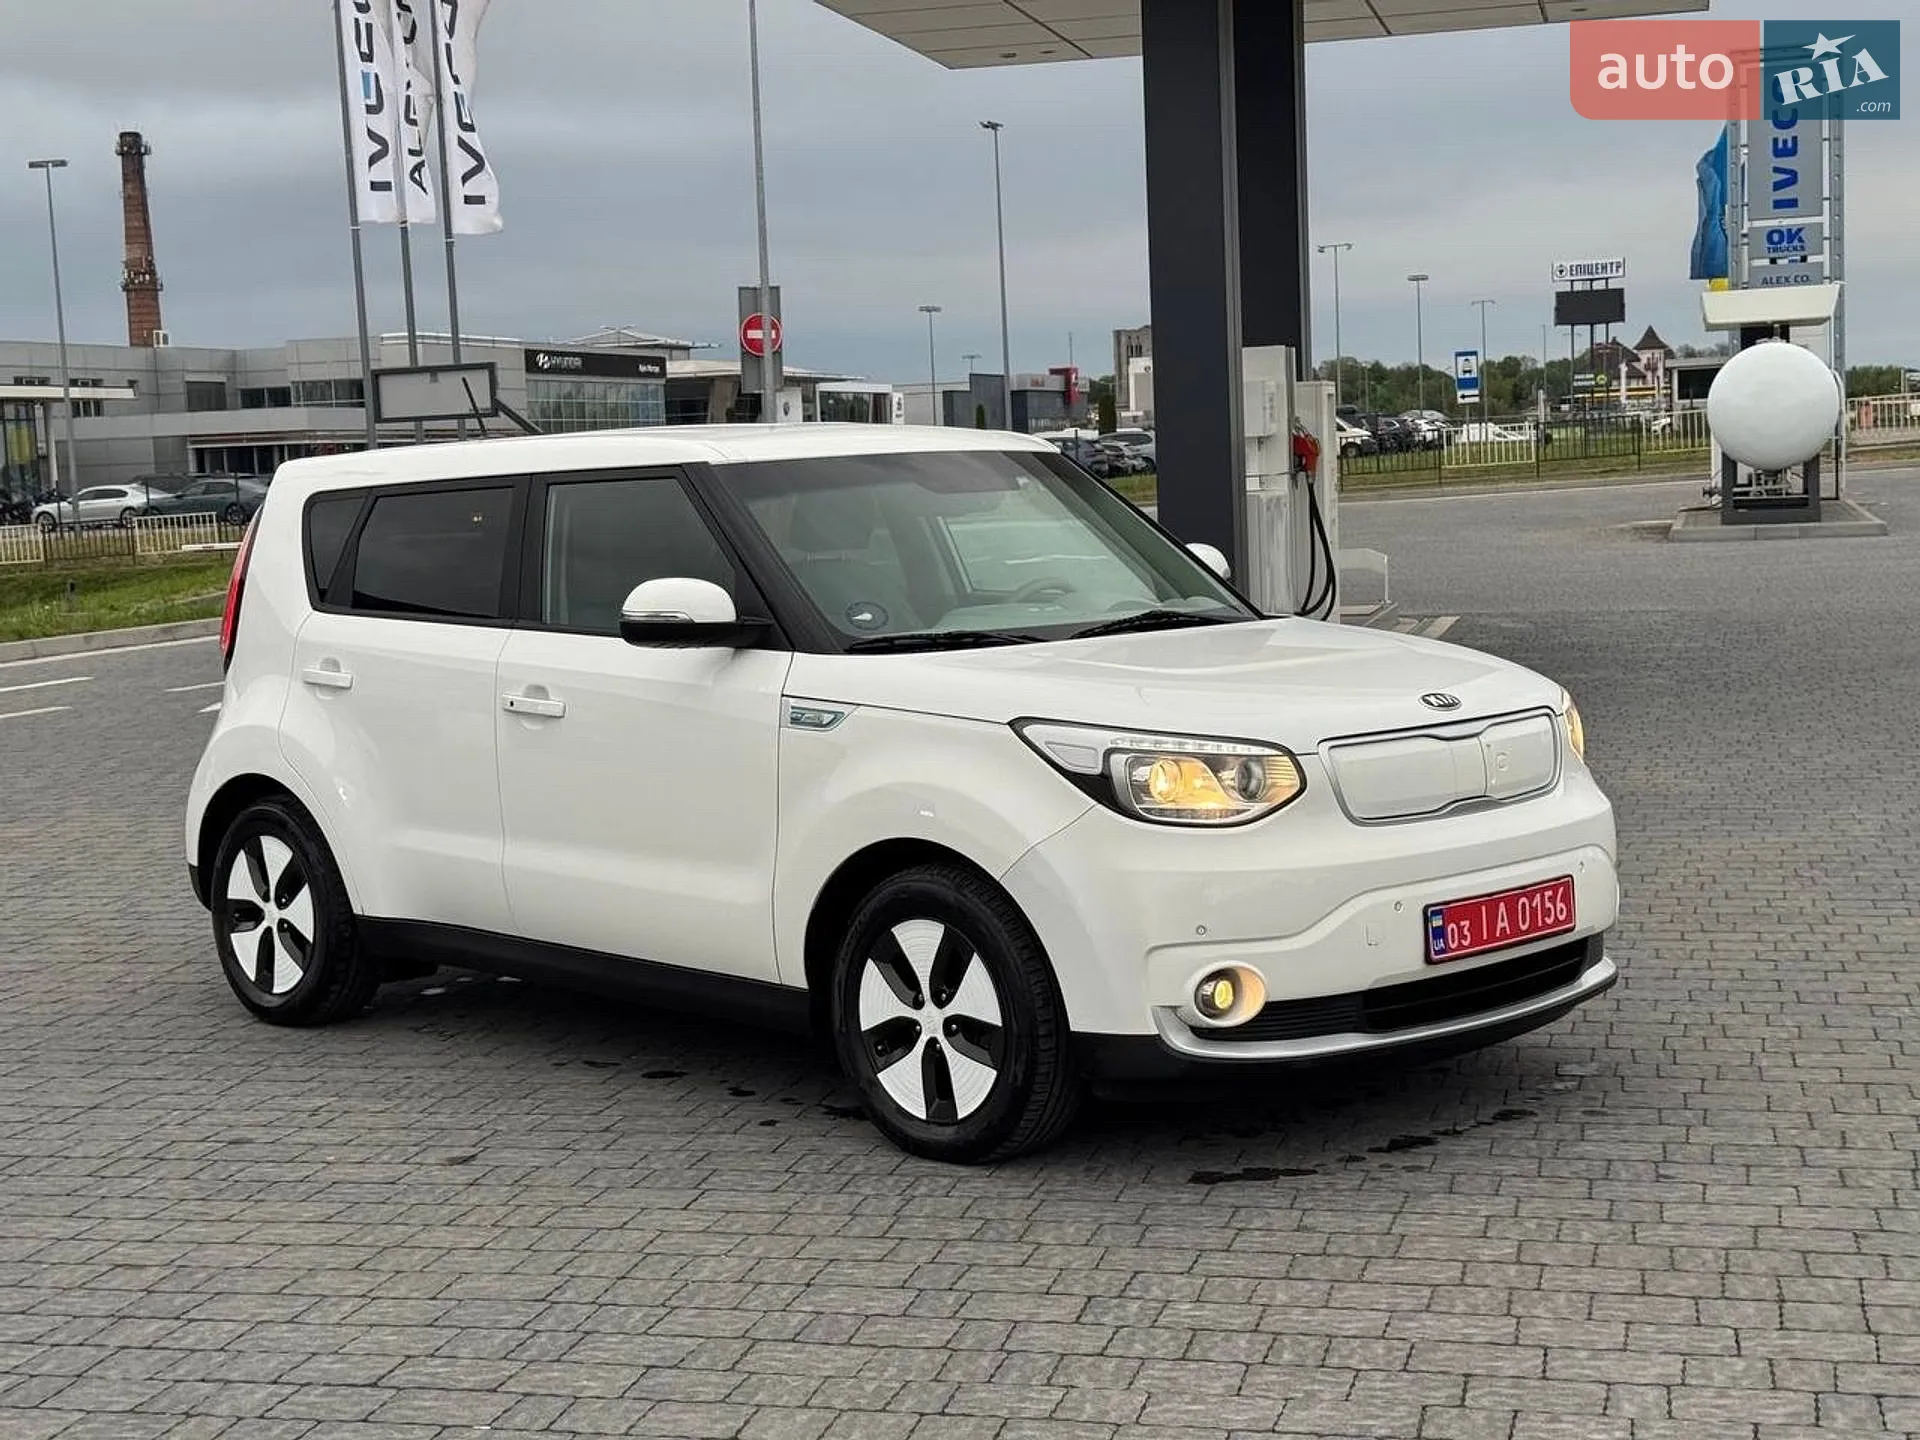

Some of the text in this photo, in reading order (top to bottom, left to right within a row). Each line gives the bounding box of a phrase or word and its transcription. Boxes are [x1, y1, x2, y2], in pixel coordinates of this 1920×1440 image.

[1766, 228, 1805, 245] OK
[1766, 245, 1805, 253] TRUCKS
[1569, 261, 1622, 277] ЕПІЦЕНТР
[1761, 276, 1791, 286] ALEX
[1424, 694, 1460, 707] KIA
[1447, 920, 1471, 949] 03
[1517, 886, 1567, 931] 0156
[1432, 938, 1446, 951] UA
